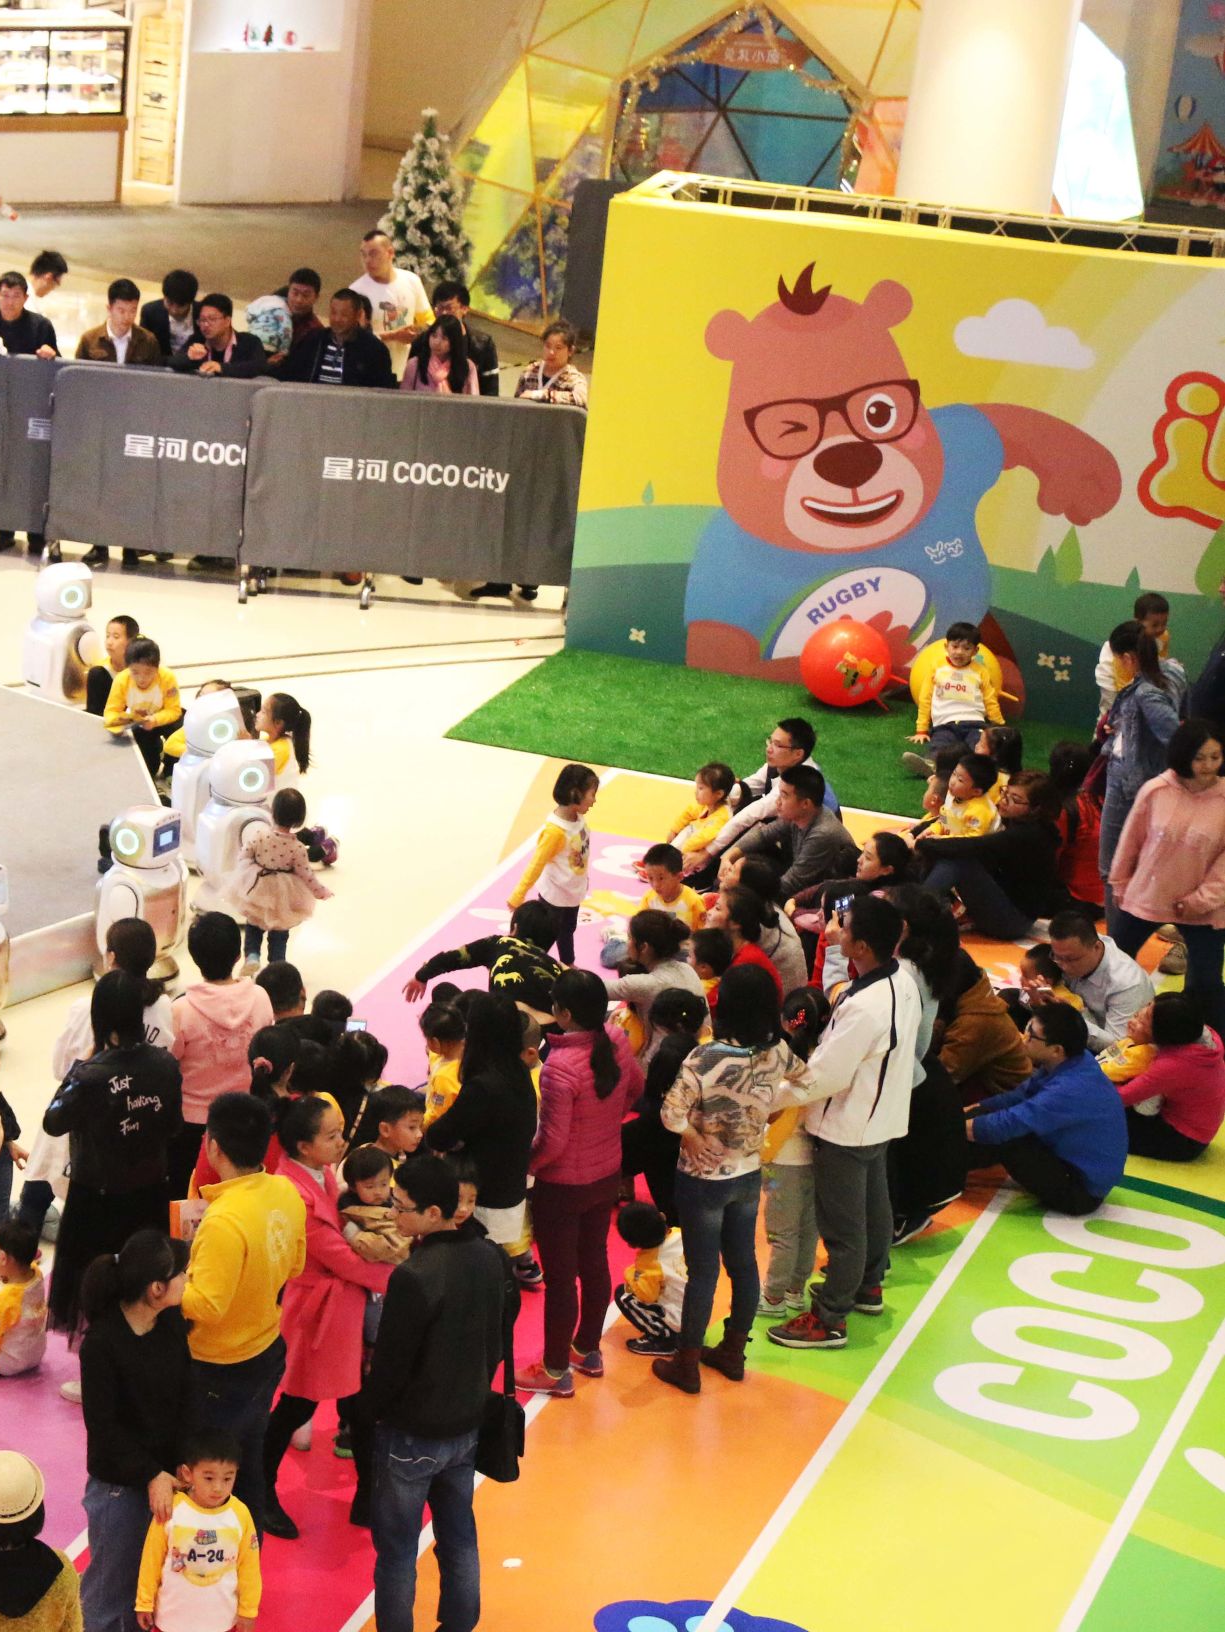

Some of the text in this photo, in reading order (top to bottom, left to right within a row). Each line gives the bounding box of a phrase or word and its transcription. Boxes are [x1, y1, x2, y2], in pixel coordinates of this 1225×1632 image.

[124, 433, 247, 467] 星河 COC
[322, 456, 510, 493] 星河 COCO City
[806, 576, 881, 625] RUGBY
[108, 1075, 133, 1094] Just
[126, 1095, 163, 1112] having
[933, 1203, 1225, 1440] COCO
[187, 1548, 225, 1563] A-24
